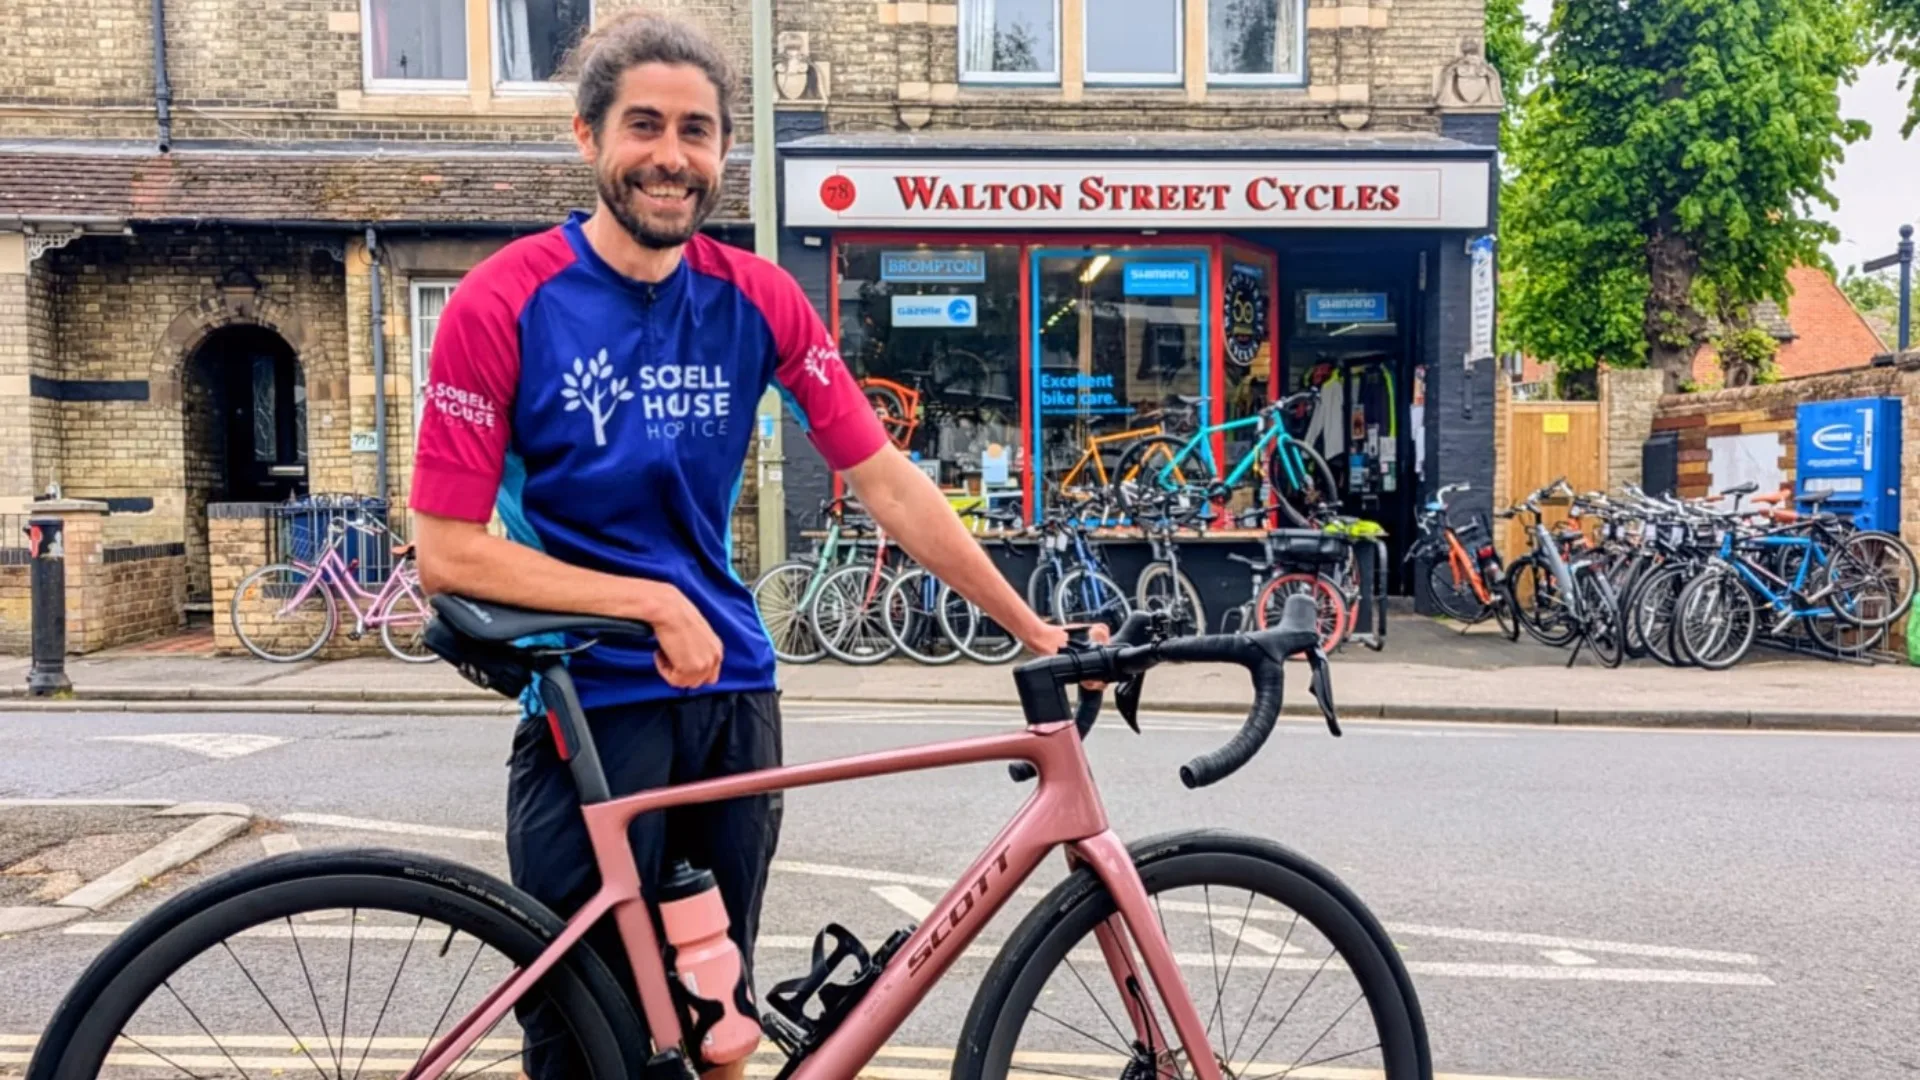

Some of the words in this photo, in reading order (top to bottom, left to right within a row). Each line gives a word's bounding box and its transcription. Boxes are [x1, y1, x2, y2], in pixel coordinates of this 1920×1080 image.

[827, 184, 849, 202] 78
[894, 175, 1064, 211] WALTON
[1078, 175, 1231, 211] STREET
[1245, 176, 1401, 211] CYCLES
[888, 258, 978, 273] BROMPTON
[1041, 372, 1114, 388] Excellent
[435, 381, 496, 412] SOBELL
[1041, 390, 1076, 406] bike
[1080, 392, 1118, 406] care.
[434, 397, 496, 429] HOUSE
[906, 843, 1012, 979] SCOTT
